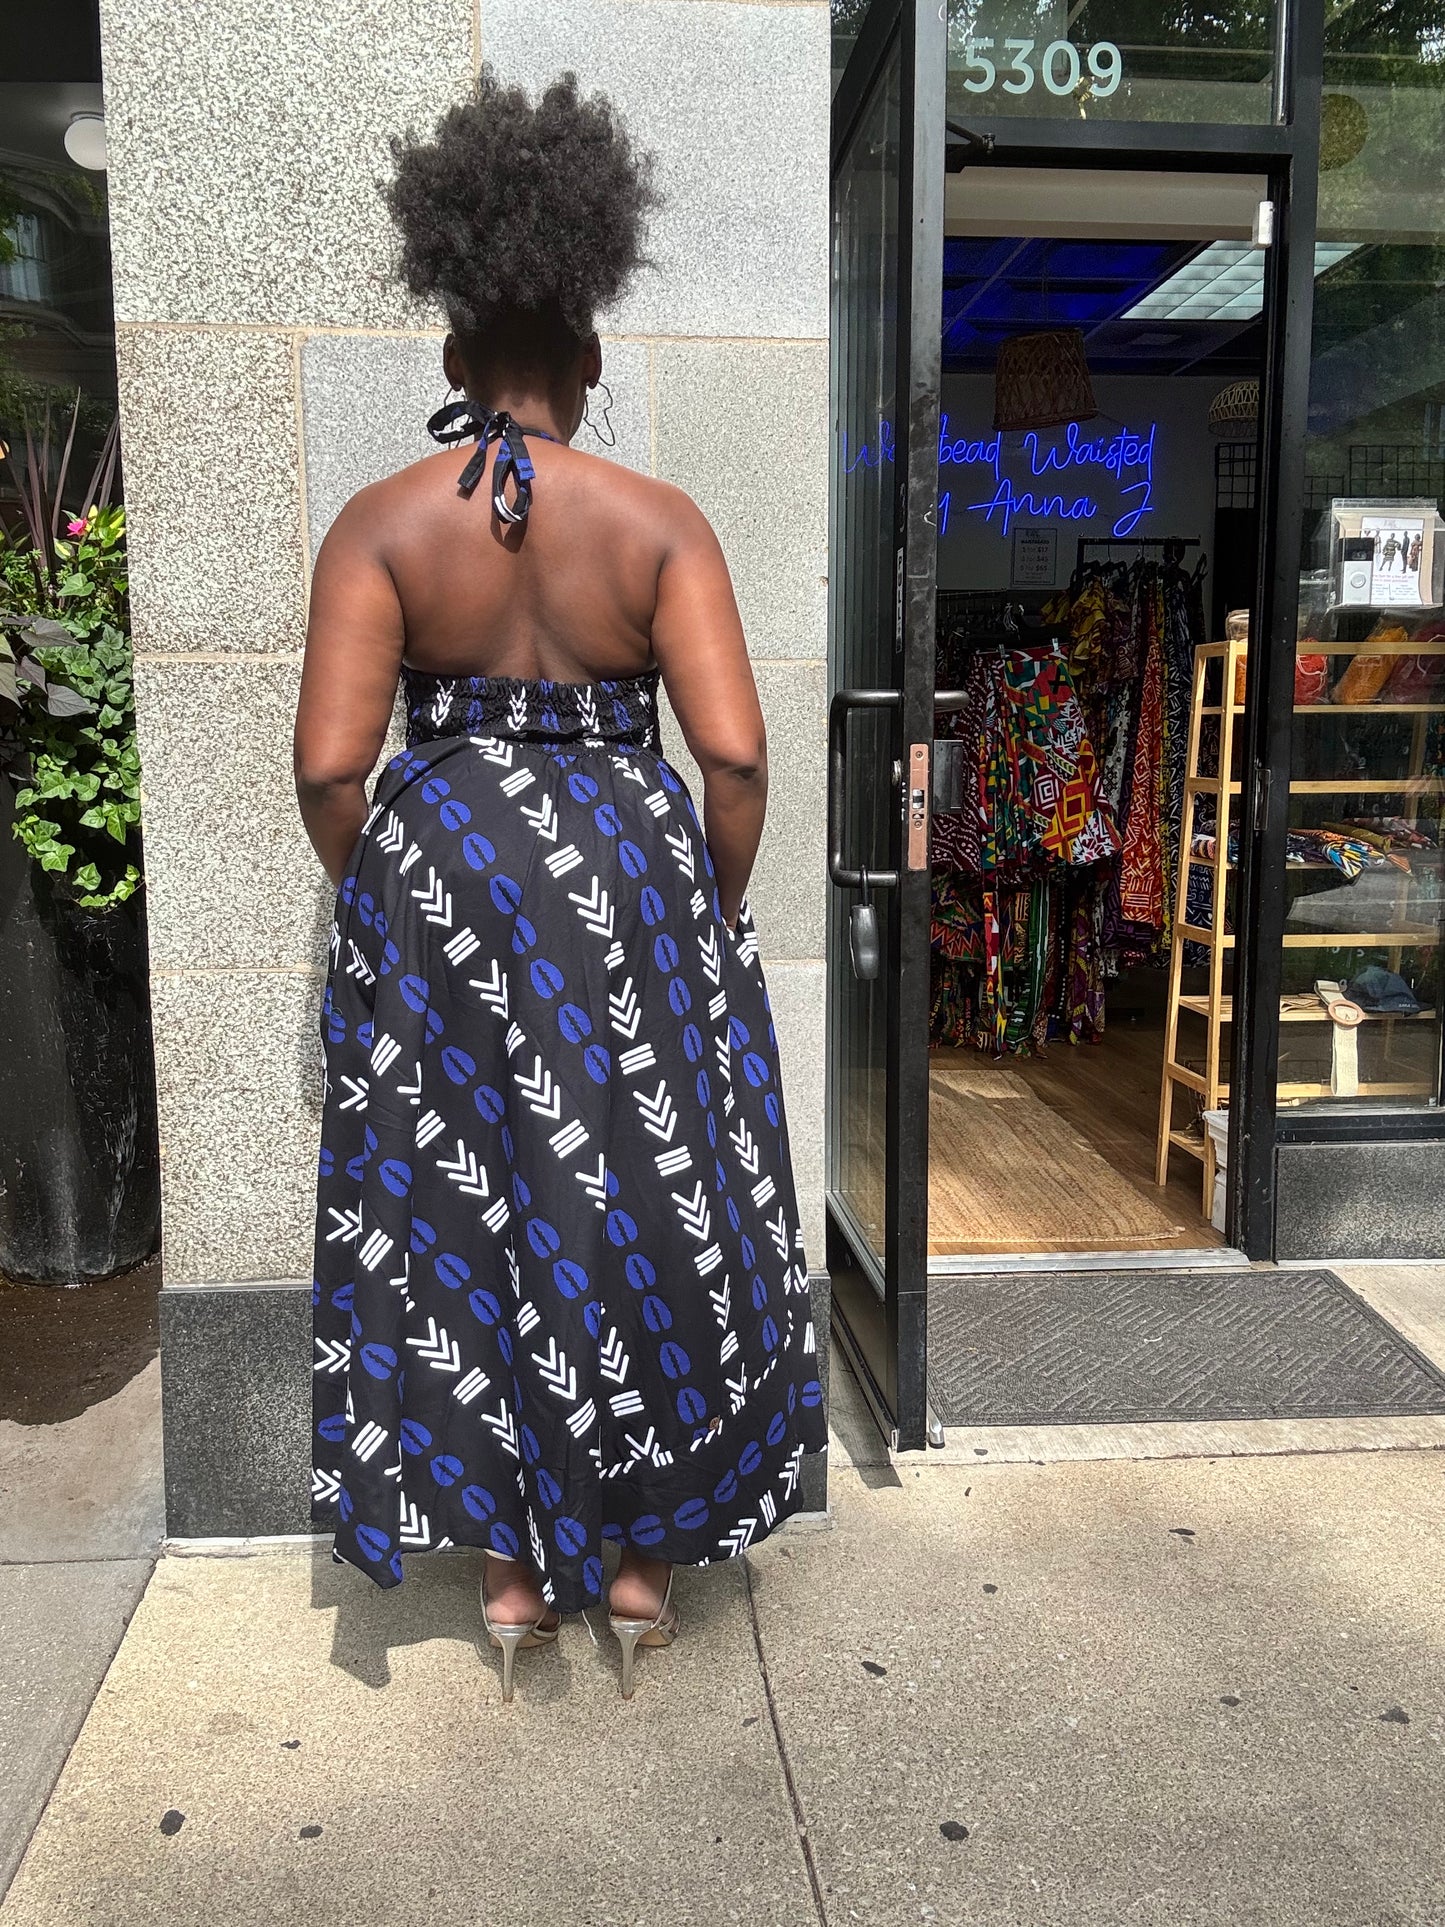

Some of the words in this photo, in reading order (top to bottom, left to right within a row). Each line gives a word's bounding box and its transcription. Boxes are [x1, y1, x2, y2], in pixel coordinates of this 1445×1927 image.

[963, 38, 1122, 97] 5309
[1022, 422, 1156, 481] Waisted
[967, 478, 1098, 536] Anna
